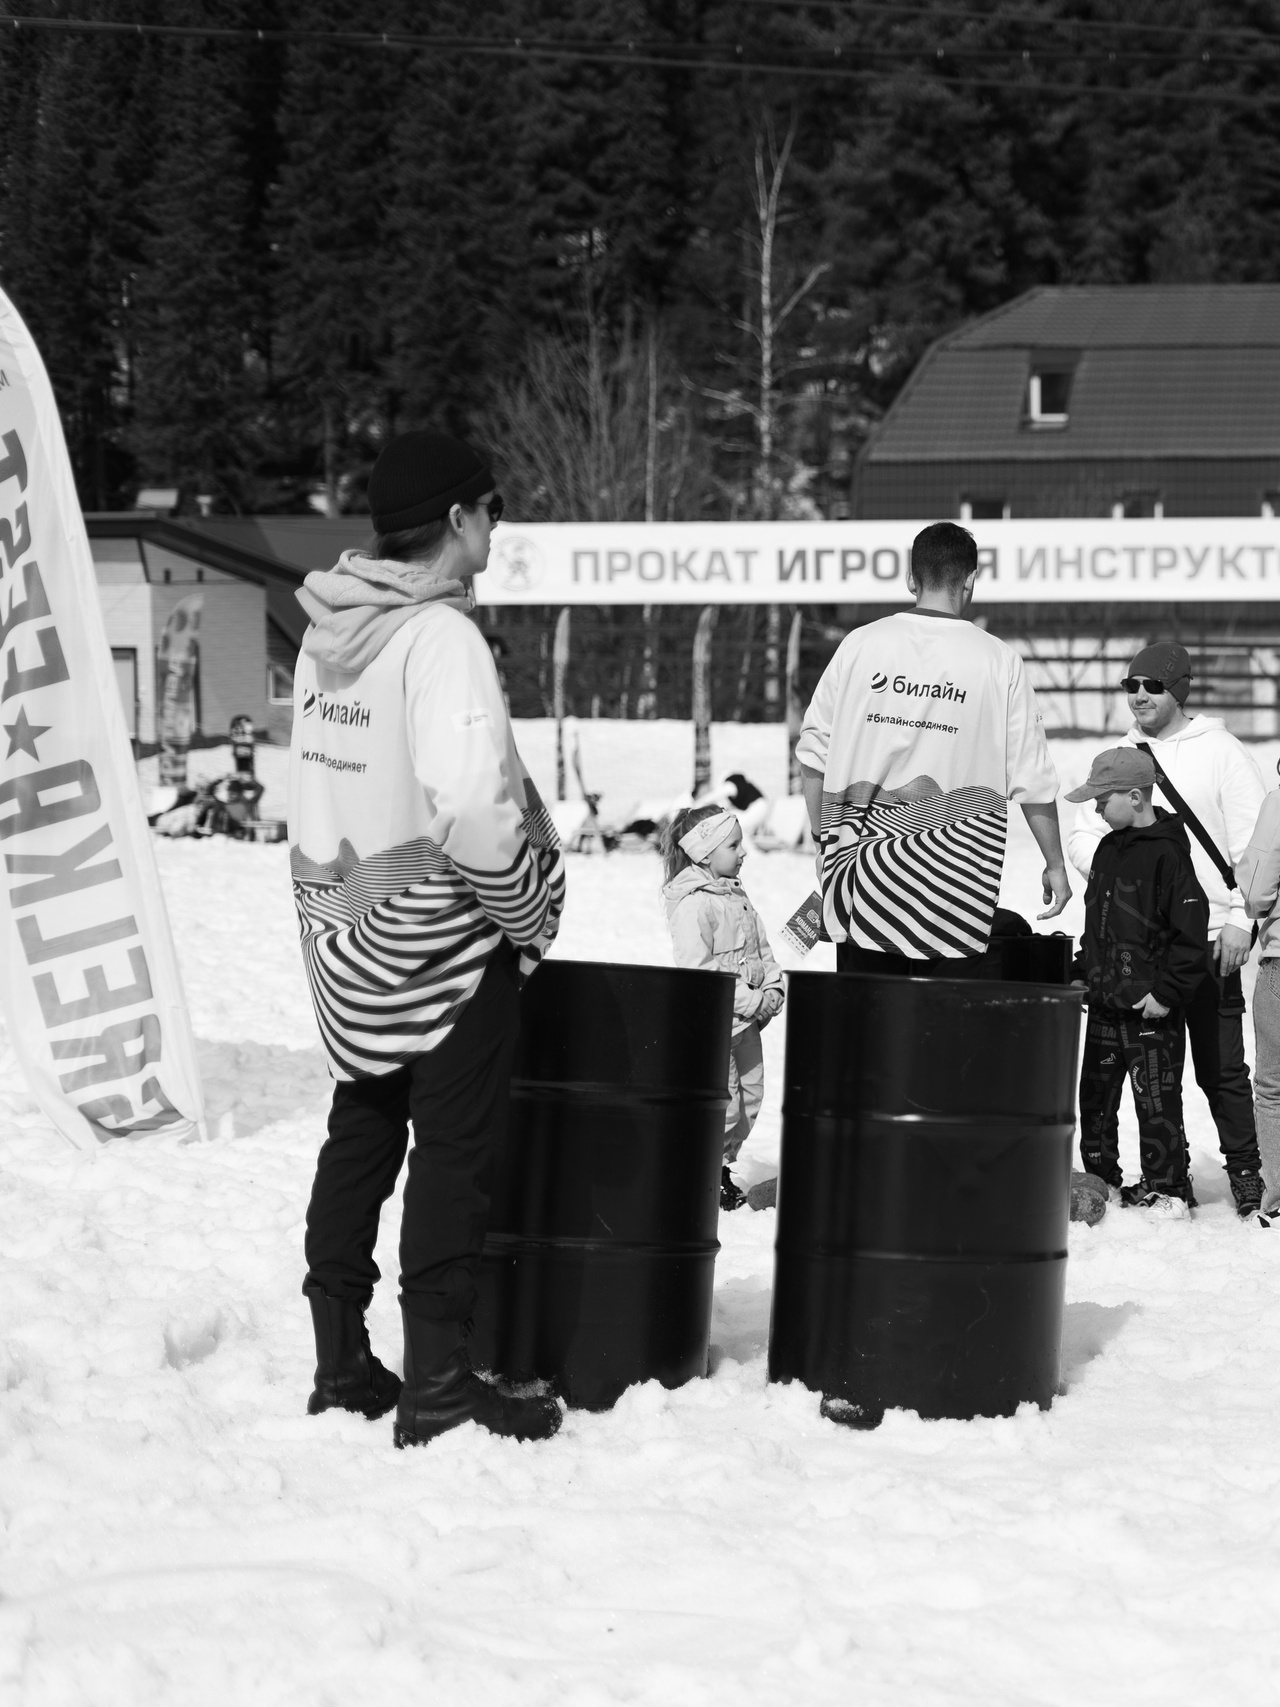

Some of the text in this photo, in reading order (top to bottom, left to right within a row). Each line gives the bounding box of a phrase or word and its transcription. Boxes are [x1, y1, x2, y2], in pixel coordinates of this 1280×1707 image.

[571, 549, 758, 582] ПРОКАТ
[778, 547, 998, 581] ИГРОЯ
[892, 675, 967, 704] билайн
[866, 711, 959, 736] #билайнсоединяет
[795, 915, 817, 940] КОМАНДА
[1148, 1048, 1159, 1079] WHERE
[1150, 1079, 1160, 1097] YOU
